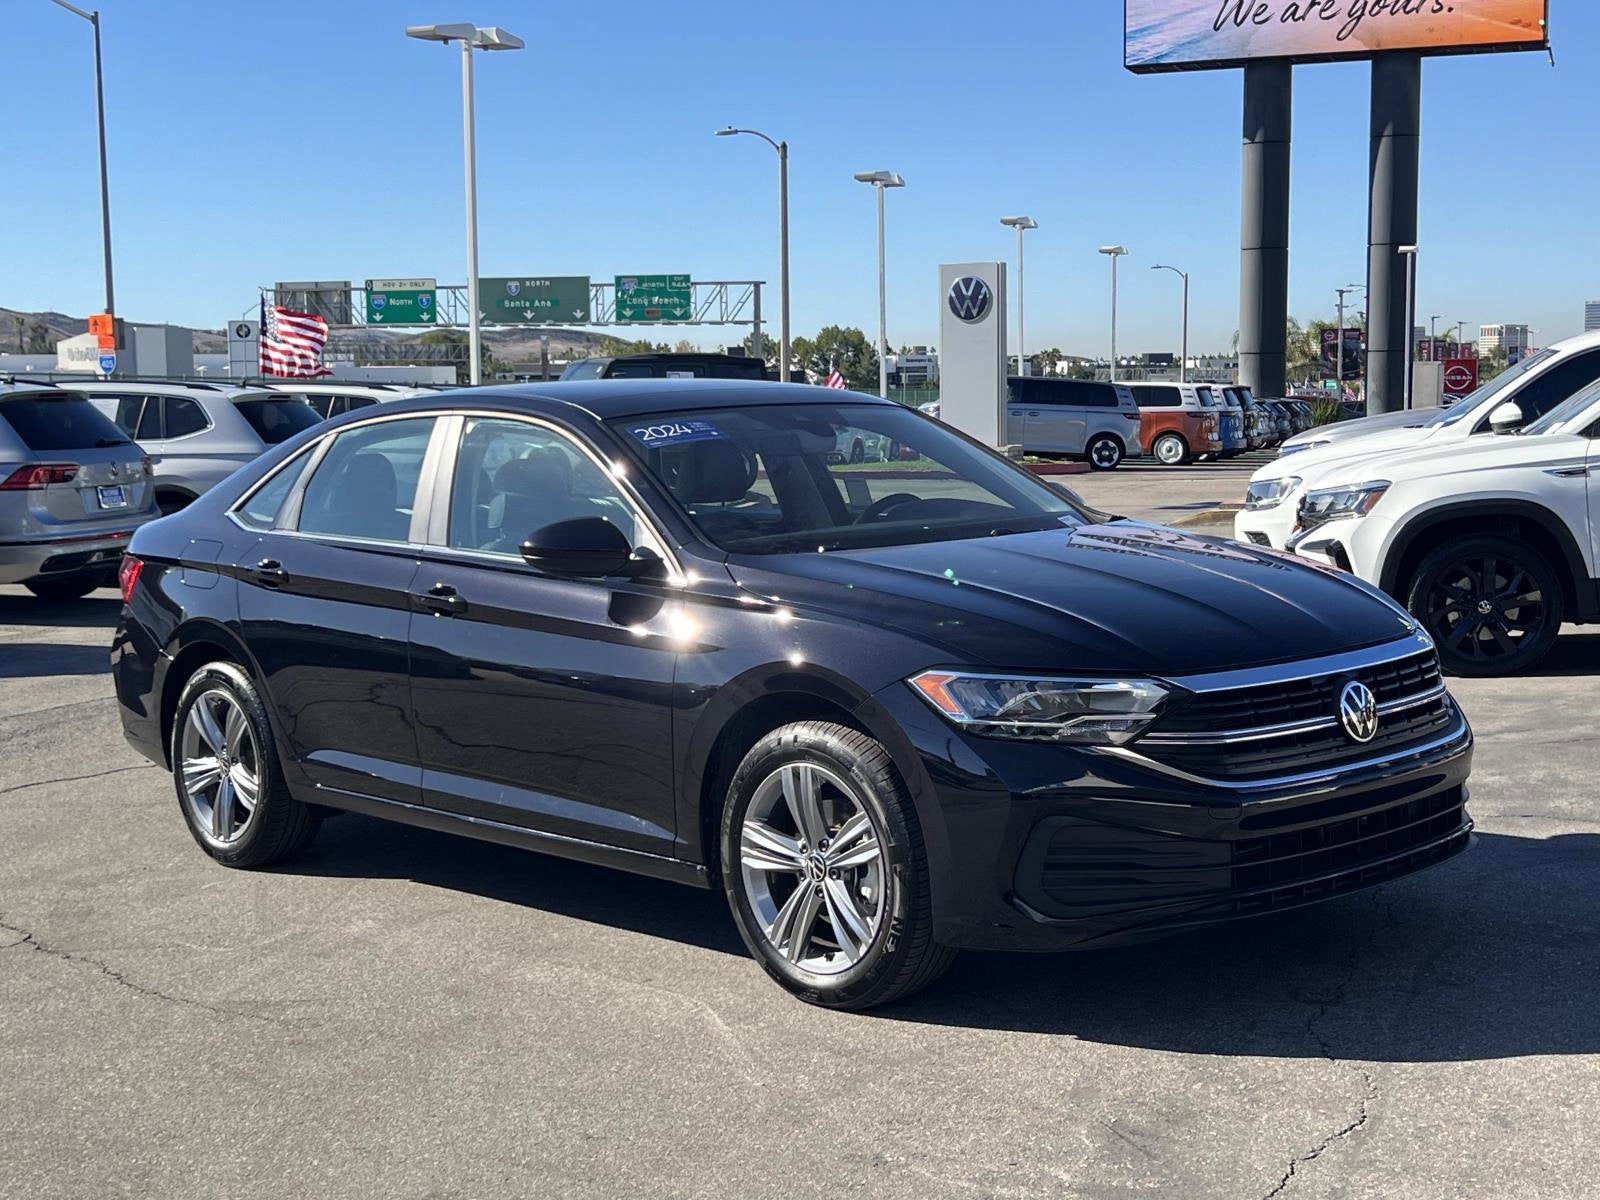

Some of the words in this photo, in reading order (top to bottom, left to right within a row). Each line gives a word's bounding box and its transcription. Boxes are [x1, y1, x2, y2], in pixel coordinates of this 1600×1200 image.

[1213, 0, 1275, 31] We
[1280, 0, 1342, 21] are
[1336, 0, 1455, 41] yours.
[504, 300, 530, 308] Santa
[626, 298, 648, 306] Long
[651, 296, 679, 305] Beach
[634, 423, 692, 440] 2024
